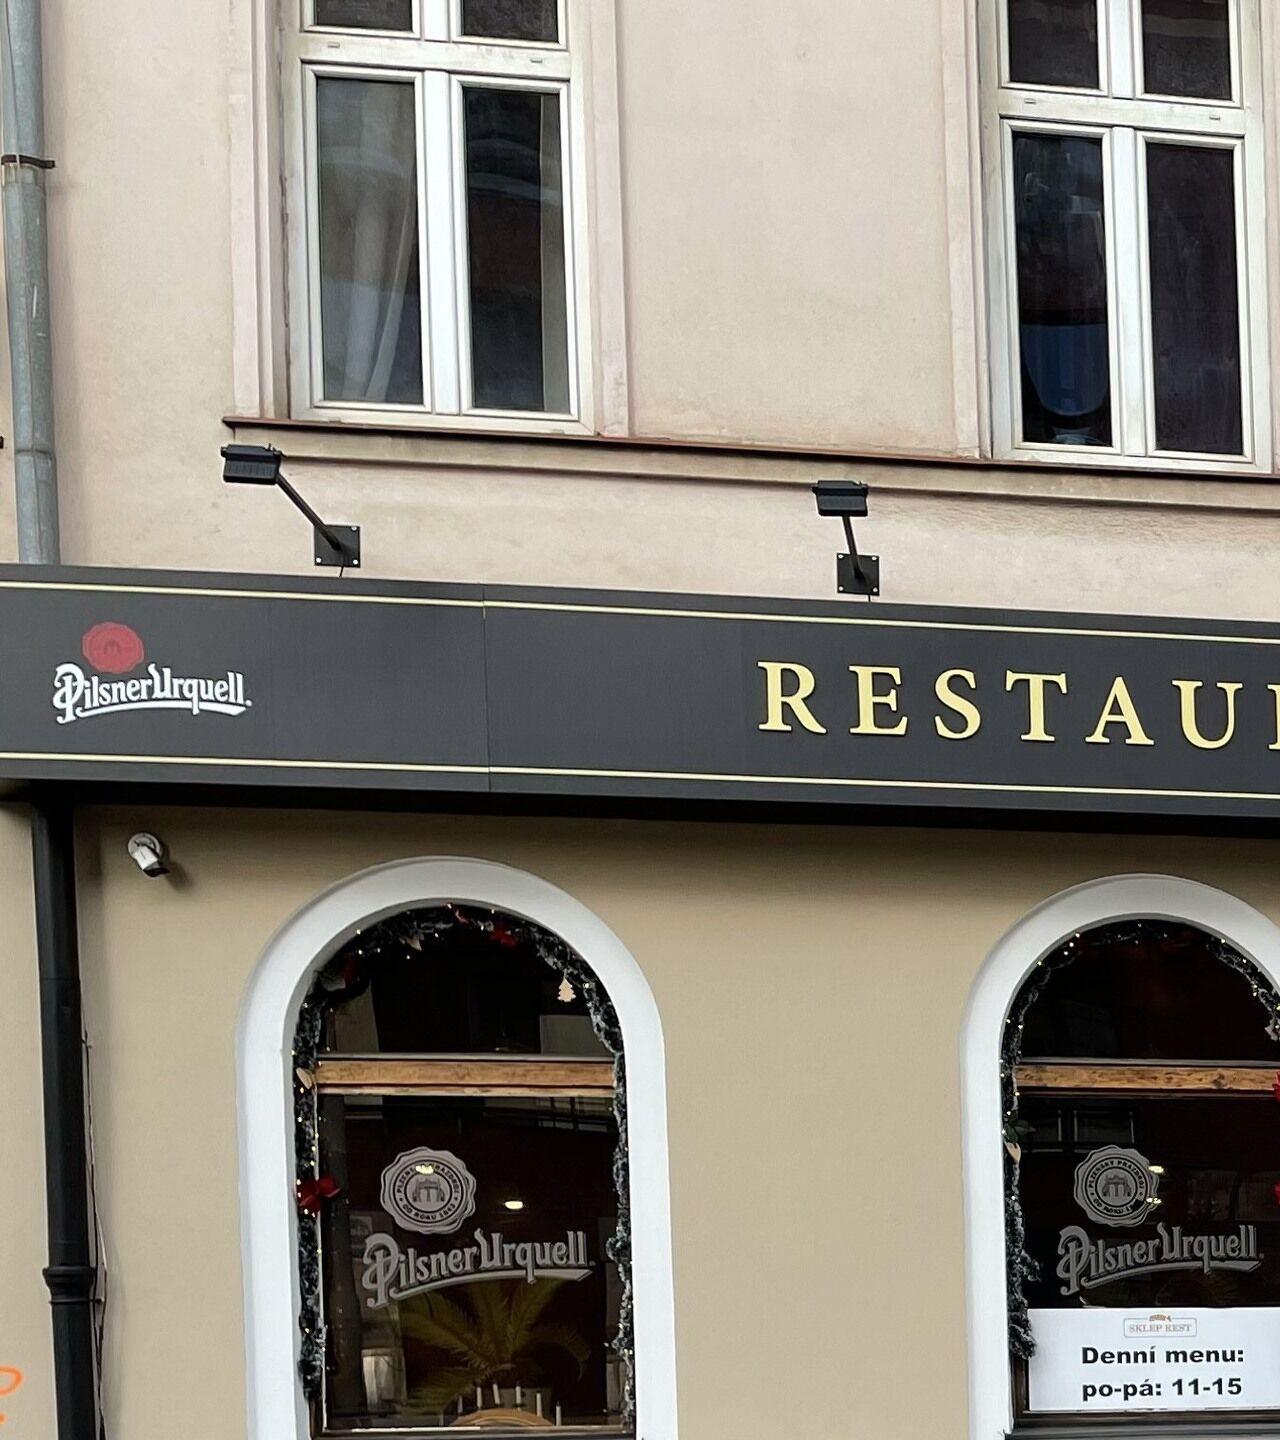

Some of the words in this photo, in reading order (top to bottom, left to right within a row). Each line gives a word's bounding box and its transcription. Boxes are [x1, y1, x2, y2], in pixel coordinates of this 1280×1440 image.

[53, 663, 153, 724] Pilsner
[149, 664, 246, 715] Urquell
[362, 1233, 479, 1309] Pilsner
[474, 1228, 588, 1285] Urquell
[1056, 1225, 1161, 1296] Pilsner
[1157, 1222, 1258, 1276] Urquell
[1128, 1324, 1163, 1333] SKLEP
[1165, 1323, 1192, 1332] REST
[1081, 1345, 1157, 1365] Denní
[1165, 1348, 1244, 1364] menu:
[1082, 1378, 1162, 1402] po-pá:
[1172, 1377, 1243, 1396] 11-15
